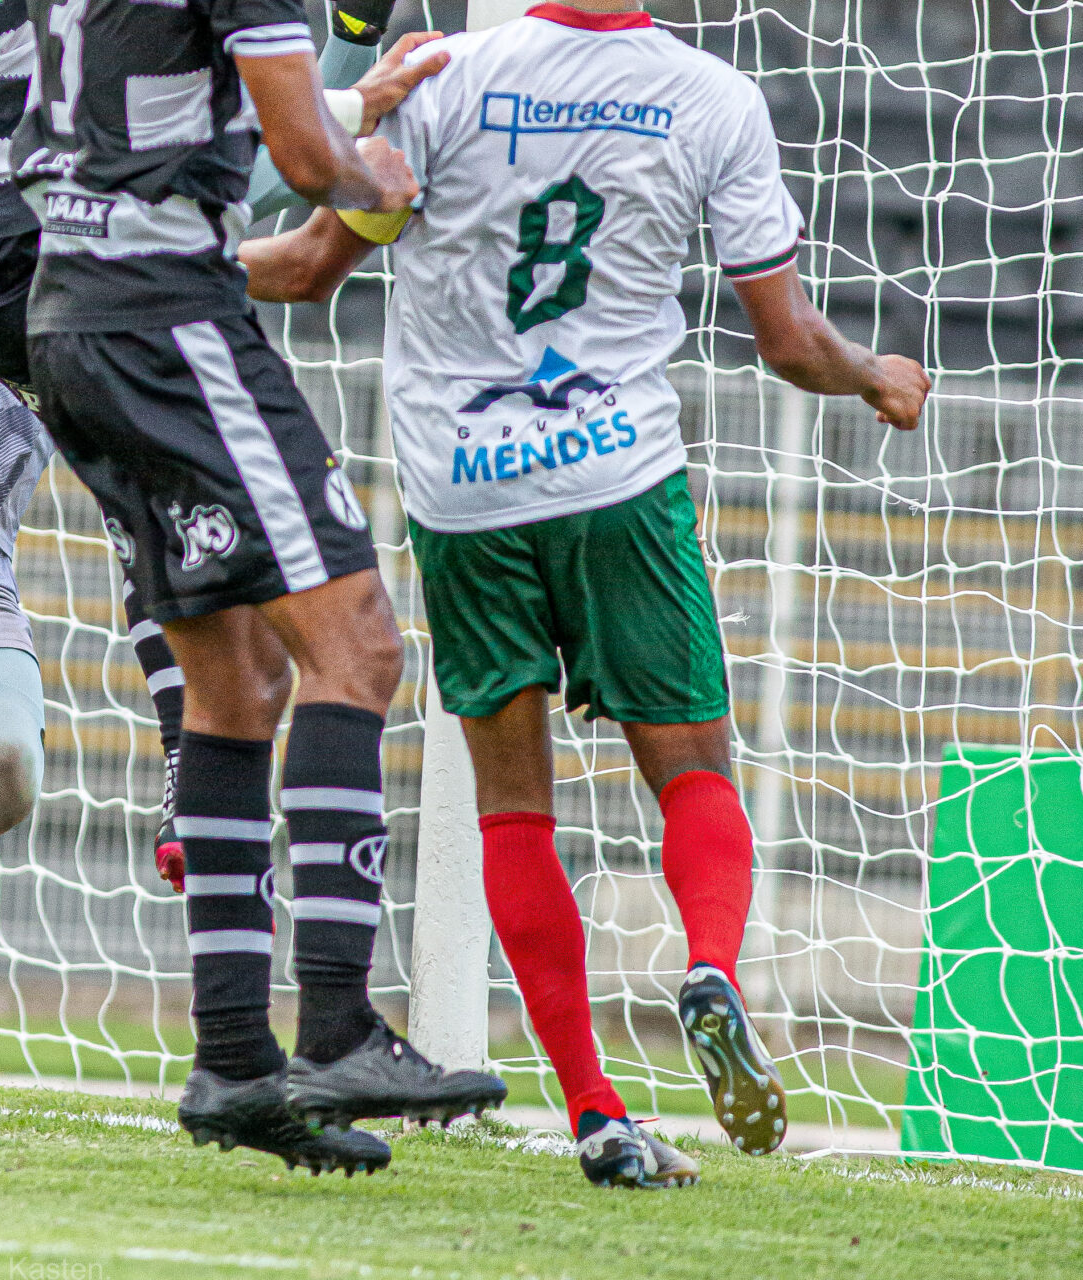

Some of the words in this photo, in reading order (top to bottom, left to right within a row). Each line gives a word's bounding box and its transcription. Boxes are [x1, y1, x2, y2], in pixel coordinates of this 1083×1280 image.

[520, 96, 674, 130] terracom
[506, 173, 606, 335] 8
[456, 393, 617, 440] GRUPO
[451, 410, 637, 485] MENDES
